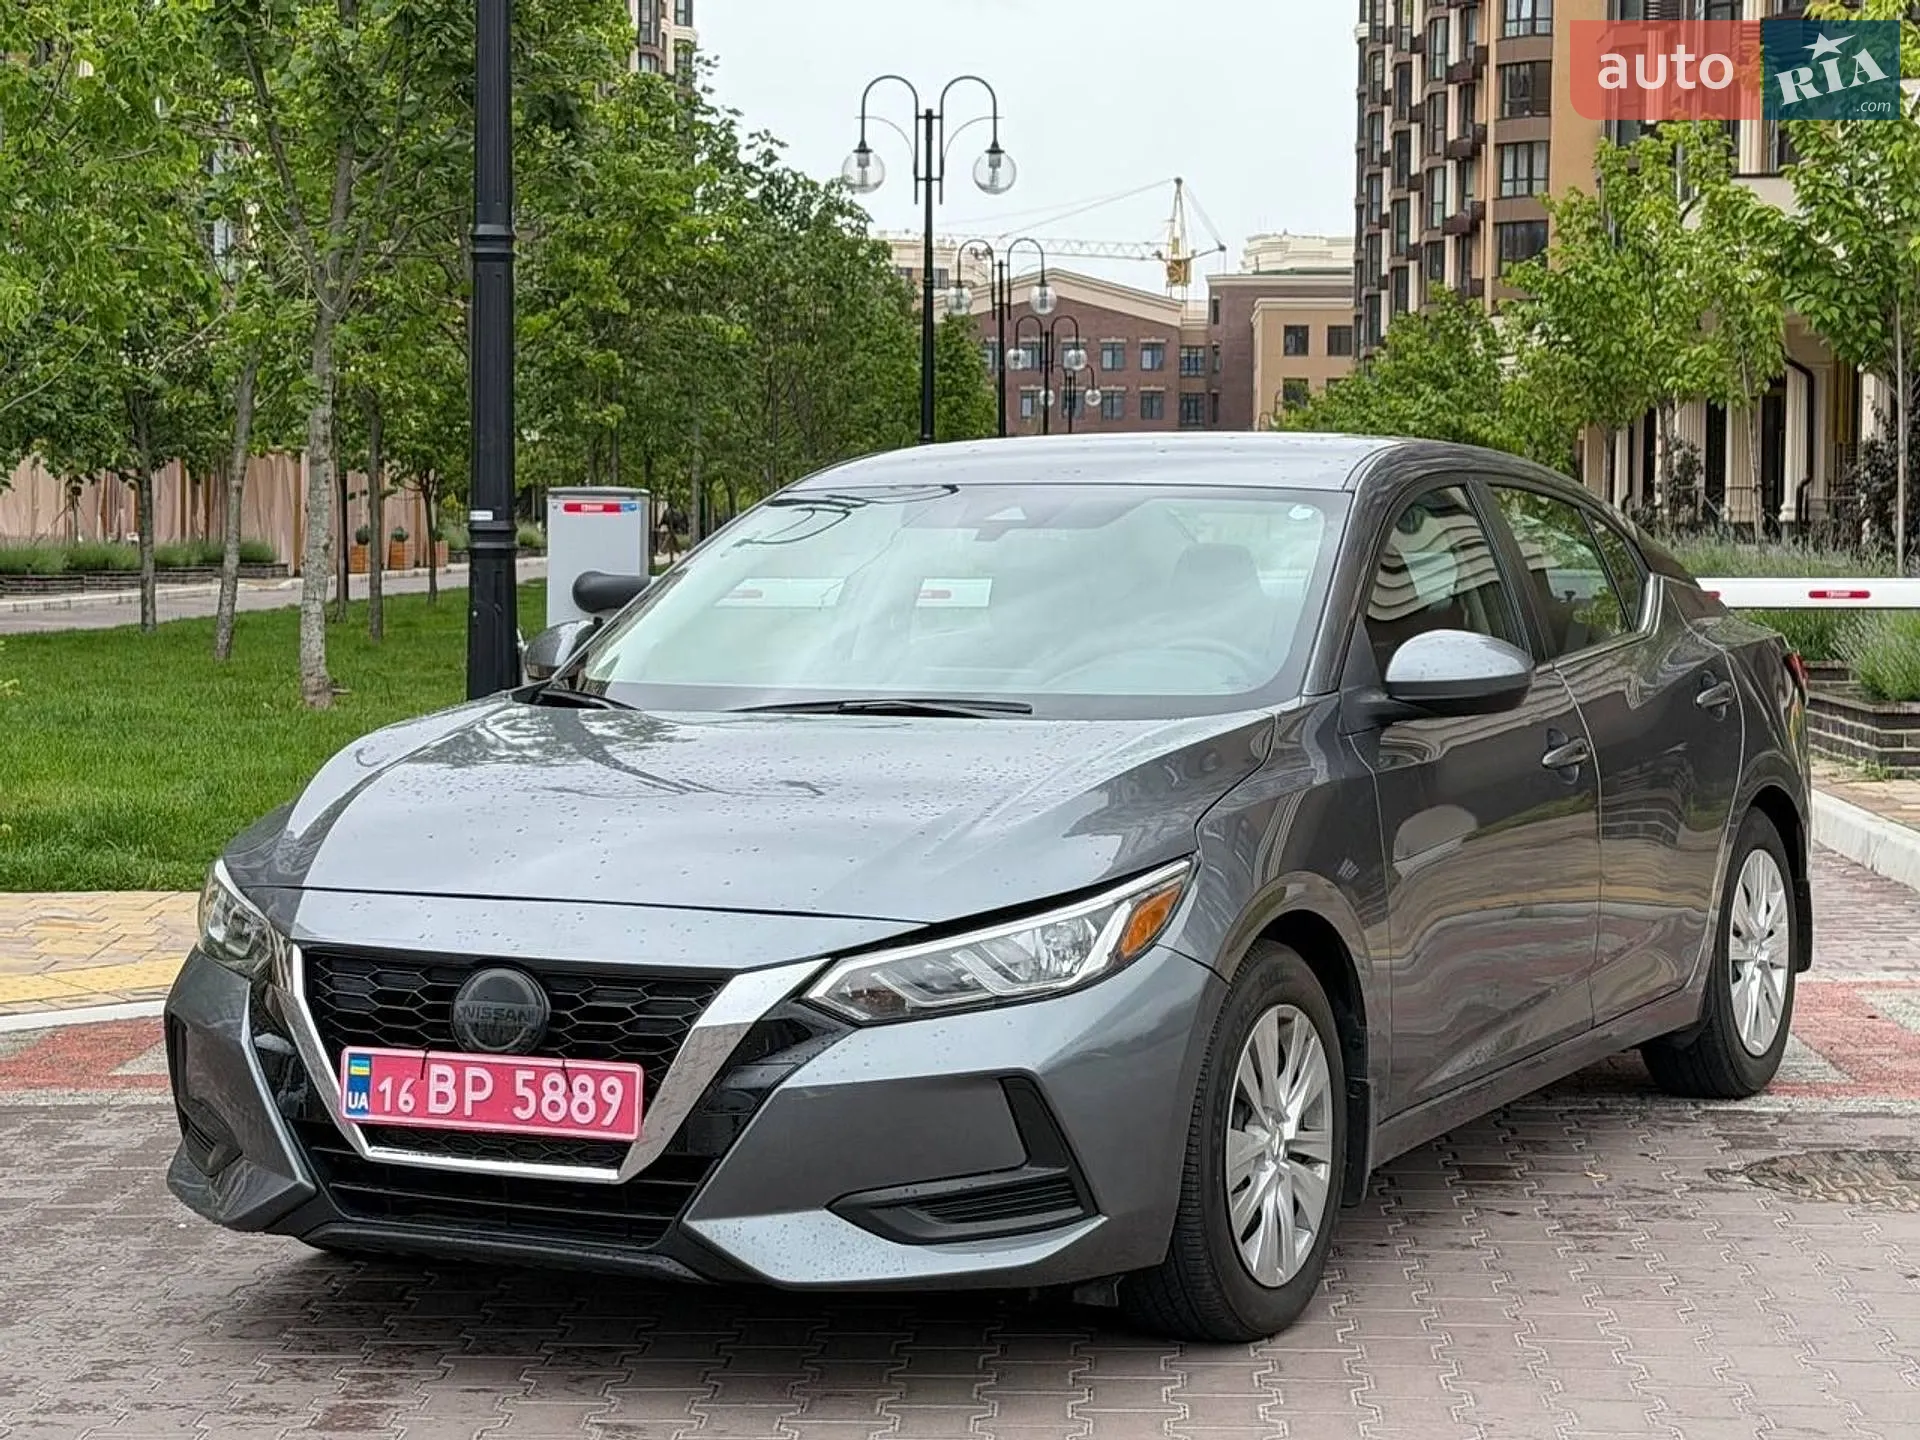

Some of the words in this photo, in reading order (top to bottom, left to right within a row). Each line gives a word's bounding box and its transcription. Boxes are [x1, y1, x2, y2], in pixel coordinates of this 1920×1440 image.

[463, 1004, 533, 1022] NISSAN
[348, 1091, 369, 1110] UA
[377, 1076, 416, 1113] 16
[427, 1063, 494, 1116] BP
[512, 1069, 624, 1127] 5889
